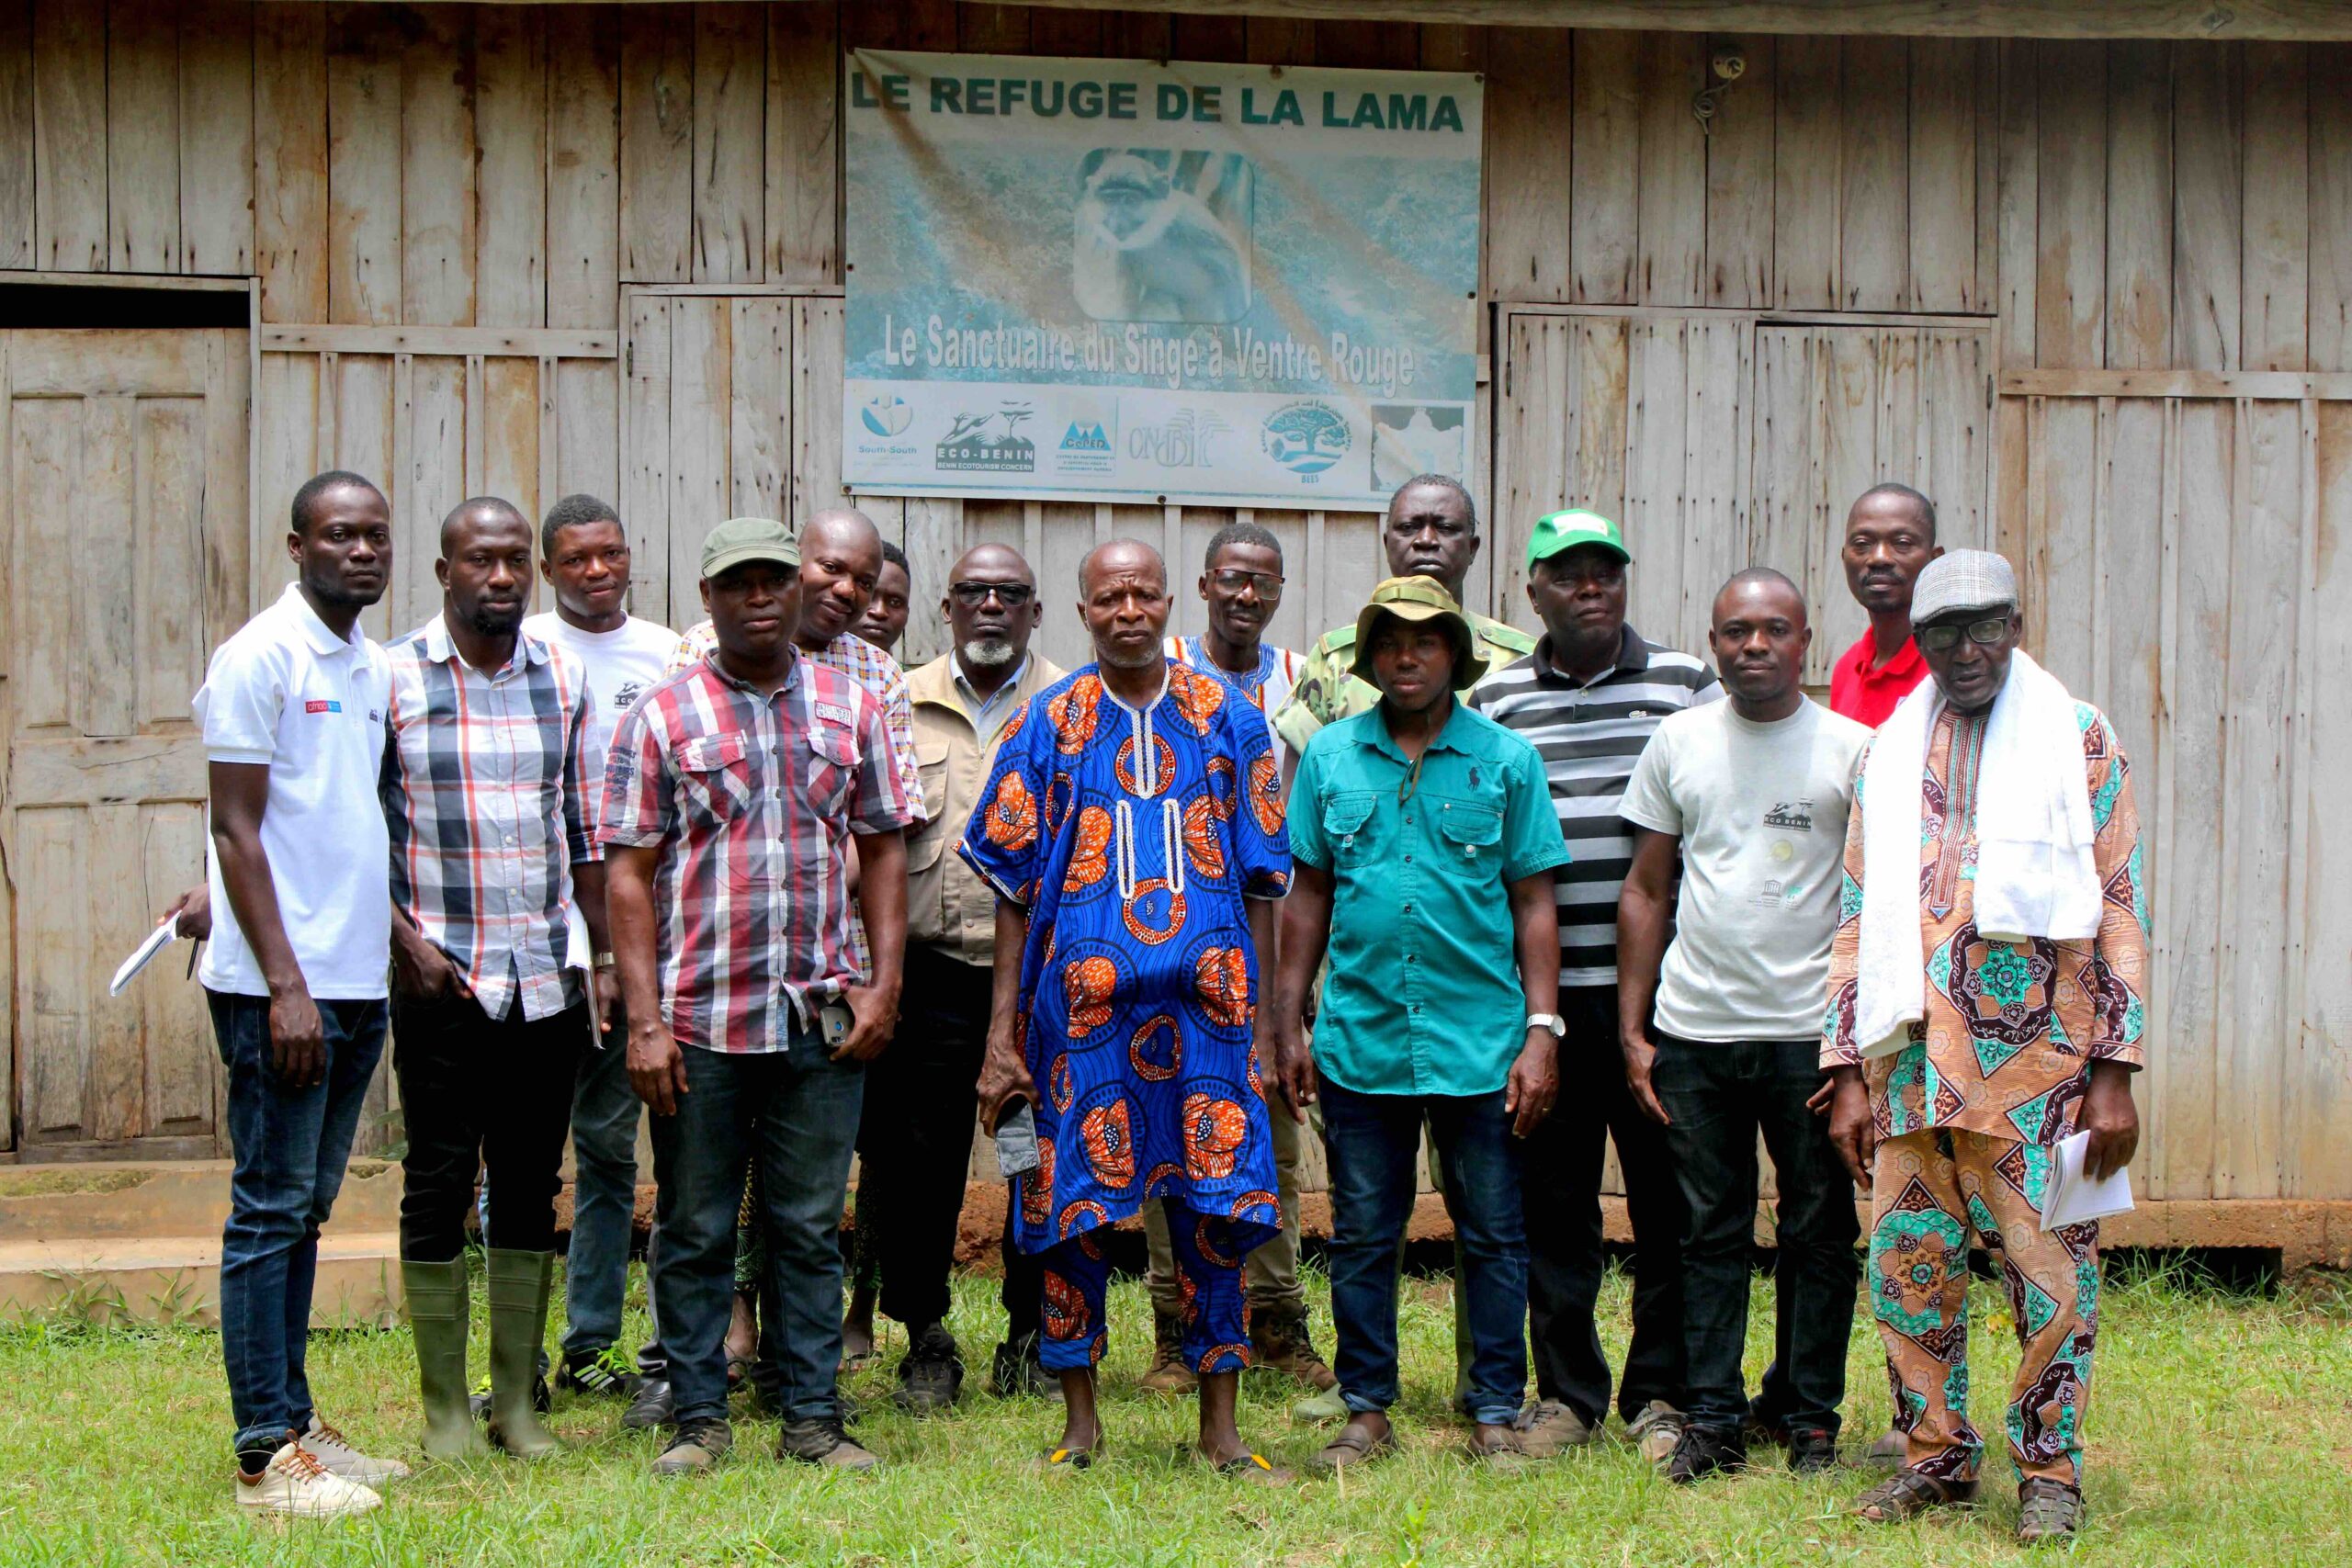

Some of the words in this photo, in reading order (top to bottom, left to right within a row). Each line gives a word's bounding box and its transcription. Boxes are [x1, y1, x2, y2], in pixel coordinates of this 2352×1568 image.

[852, 72, 910, 112] LE
[930, 76, 1137, 119] REFUGE
[1156, 84, 1222, 122] DE
[1240, 87, 1305, 126] LA
[1322, 90, 1464, 132] LAMA
[885, 314, 917, 367] Le
[926, 314, 1075, 371] Sanctuaire
[1083, 321, 1116, 373] du
[1125, 322, 1198, 389] Singe
[1208, 325, 1224, 378] à
[1234, 327, 1323, 381] Ventre
[1332, 332, 1415, 398] Rouge
[858, 445, 917, 455] South-South
[936, 447, 1034, 460] ECO-BENIN
[958, 462, 1000, 470] ECOTOURISM
[1001, 463, 1033, 471] CONCERN
[1301, 473, 1319, 484] BEES
